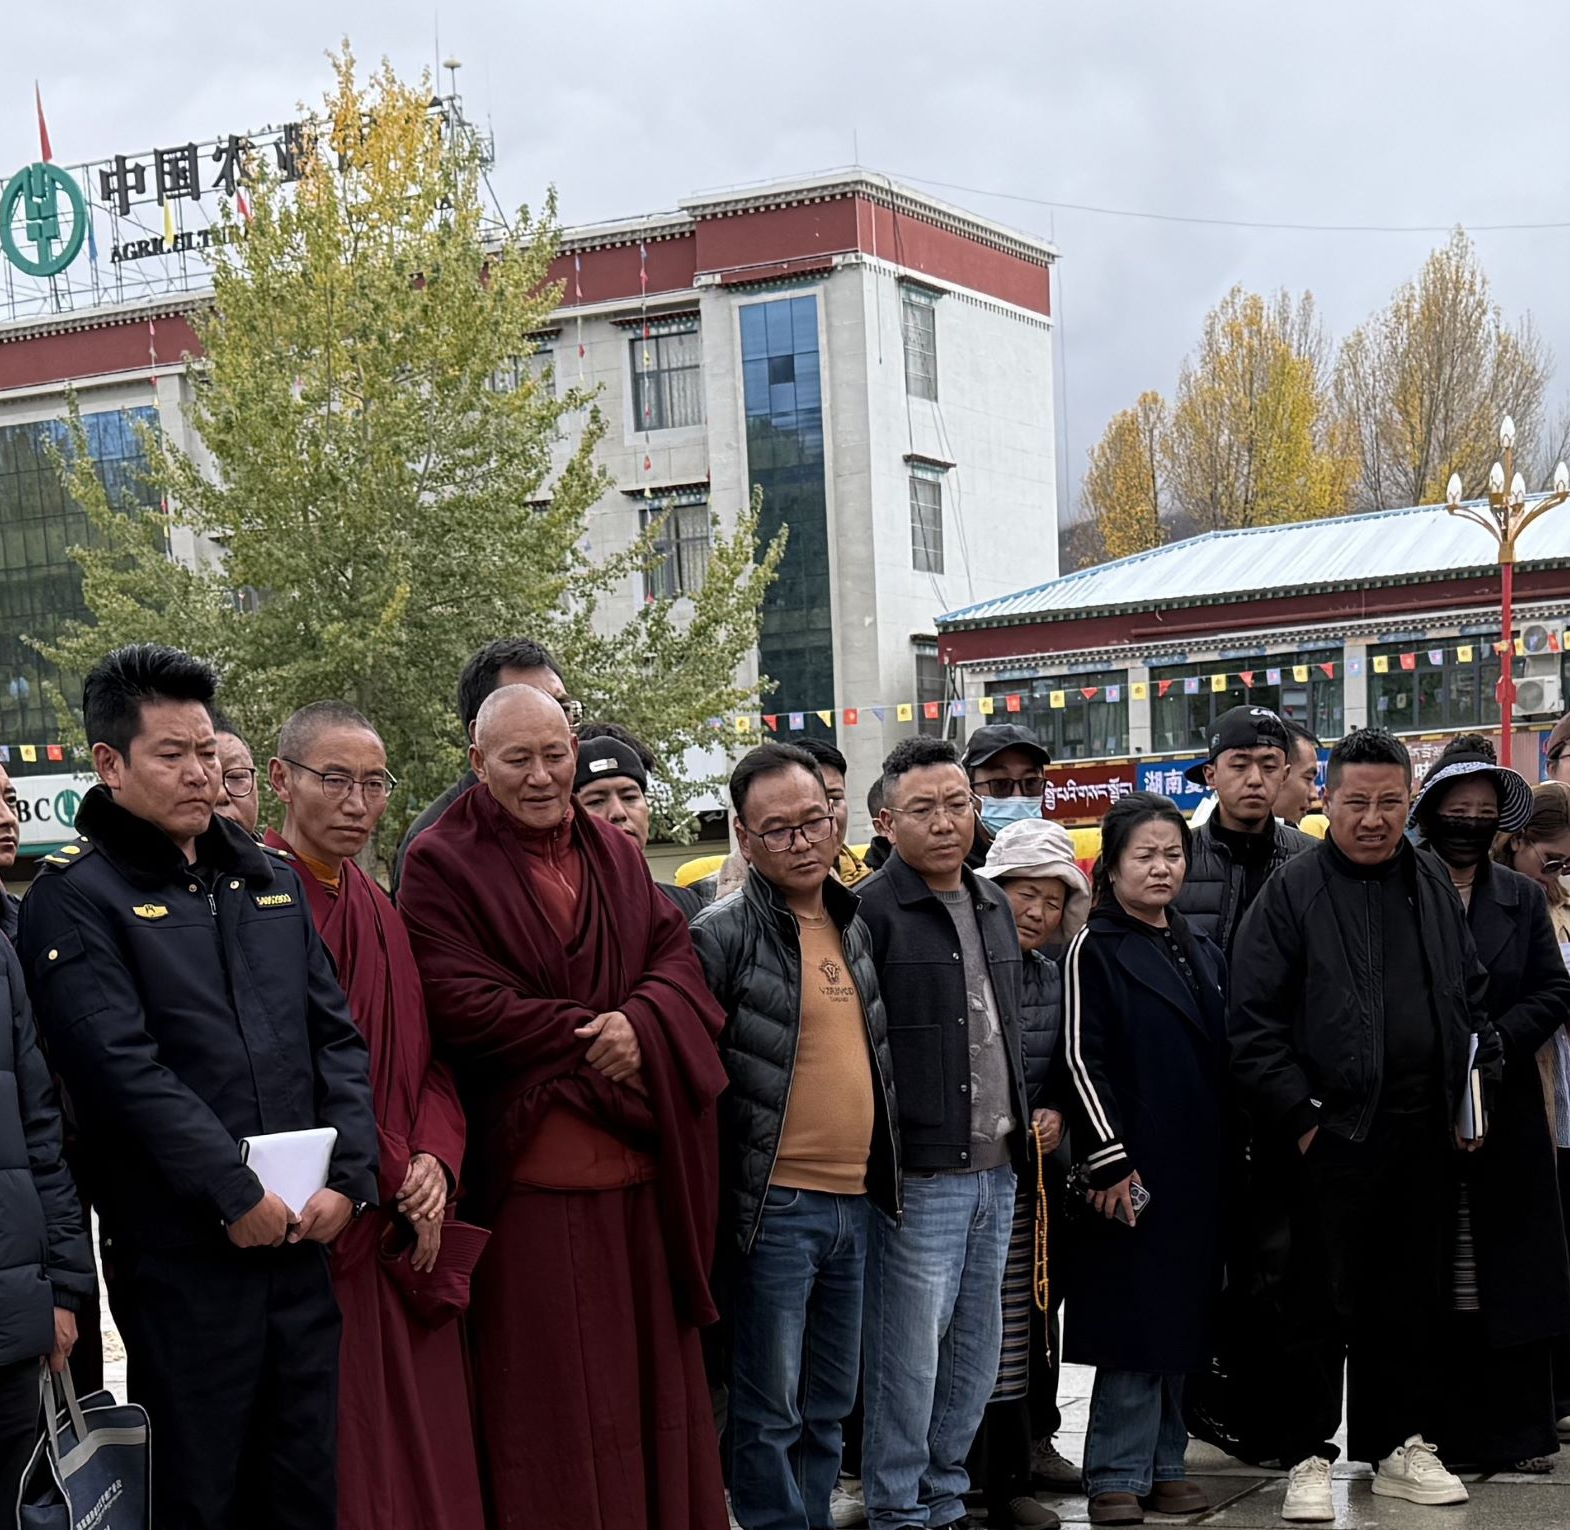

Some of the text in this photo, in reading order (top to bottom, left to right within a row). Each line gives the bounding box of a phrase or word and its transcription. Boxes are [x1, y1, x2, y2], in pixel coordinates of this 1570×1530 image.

[100, 105, 404, 216] 中国农业
[17, 797, 52, 823] BC
